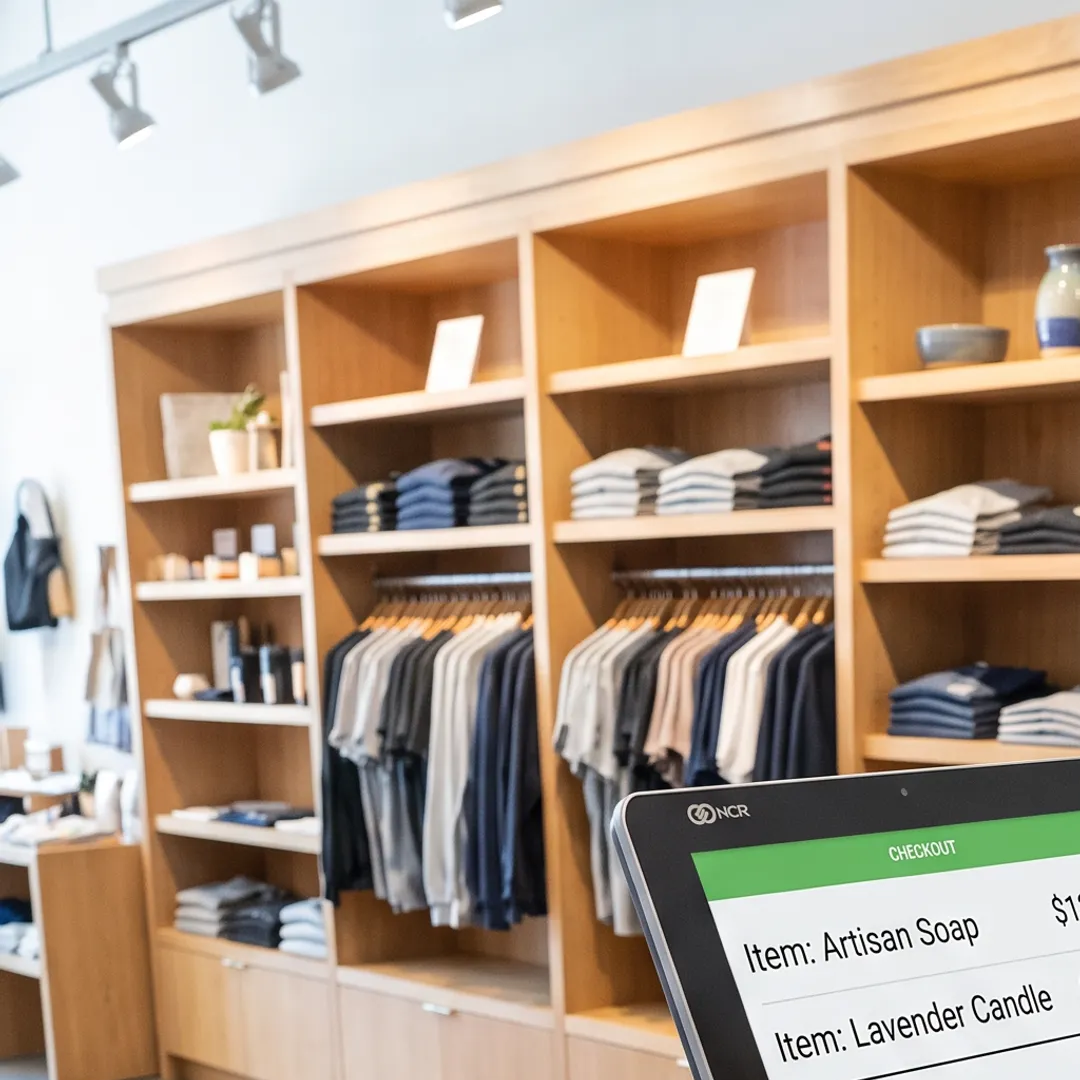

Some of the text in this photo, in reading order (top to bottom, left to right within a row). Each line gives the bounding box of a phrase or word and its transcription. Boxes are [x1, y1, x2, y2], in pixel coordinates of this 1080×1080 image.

[716, 804, 751, 819] NCR
[888, 839, 956, 862] CHECKOUT
[743, 942, 816, 974] Item:
[823, 926, 914, 961] Artisan
[916, 917, 979, 946] Soap
[774, 1028, 847, 1063] Item:
[850, 1002, 965, 1048] Lavender
[971, 983, 1054, 1024] Candle
